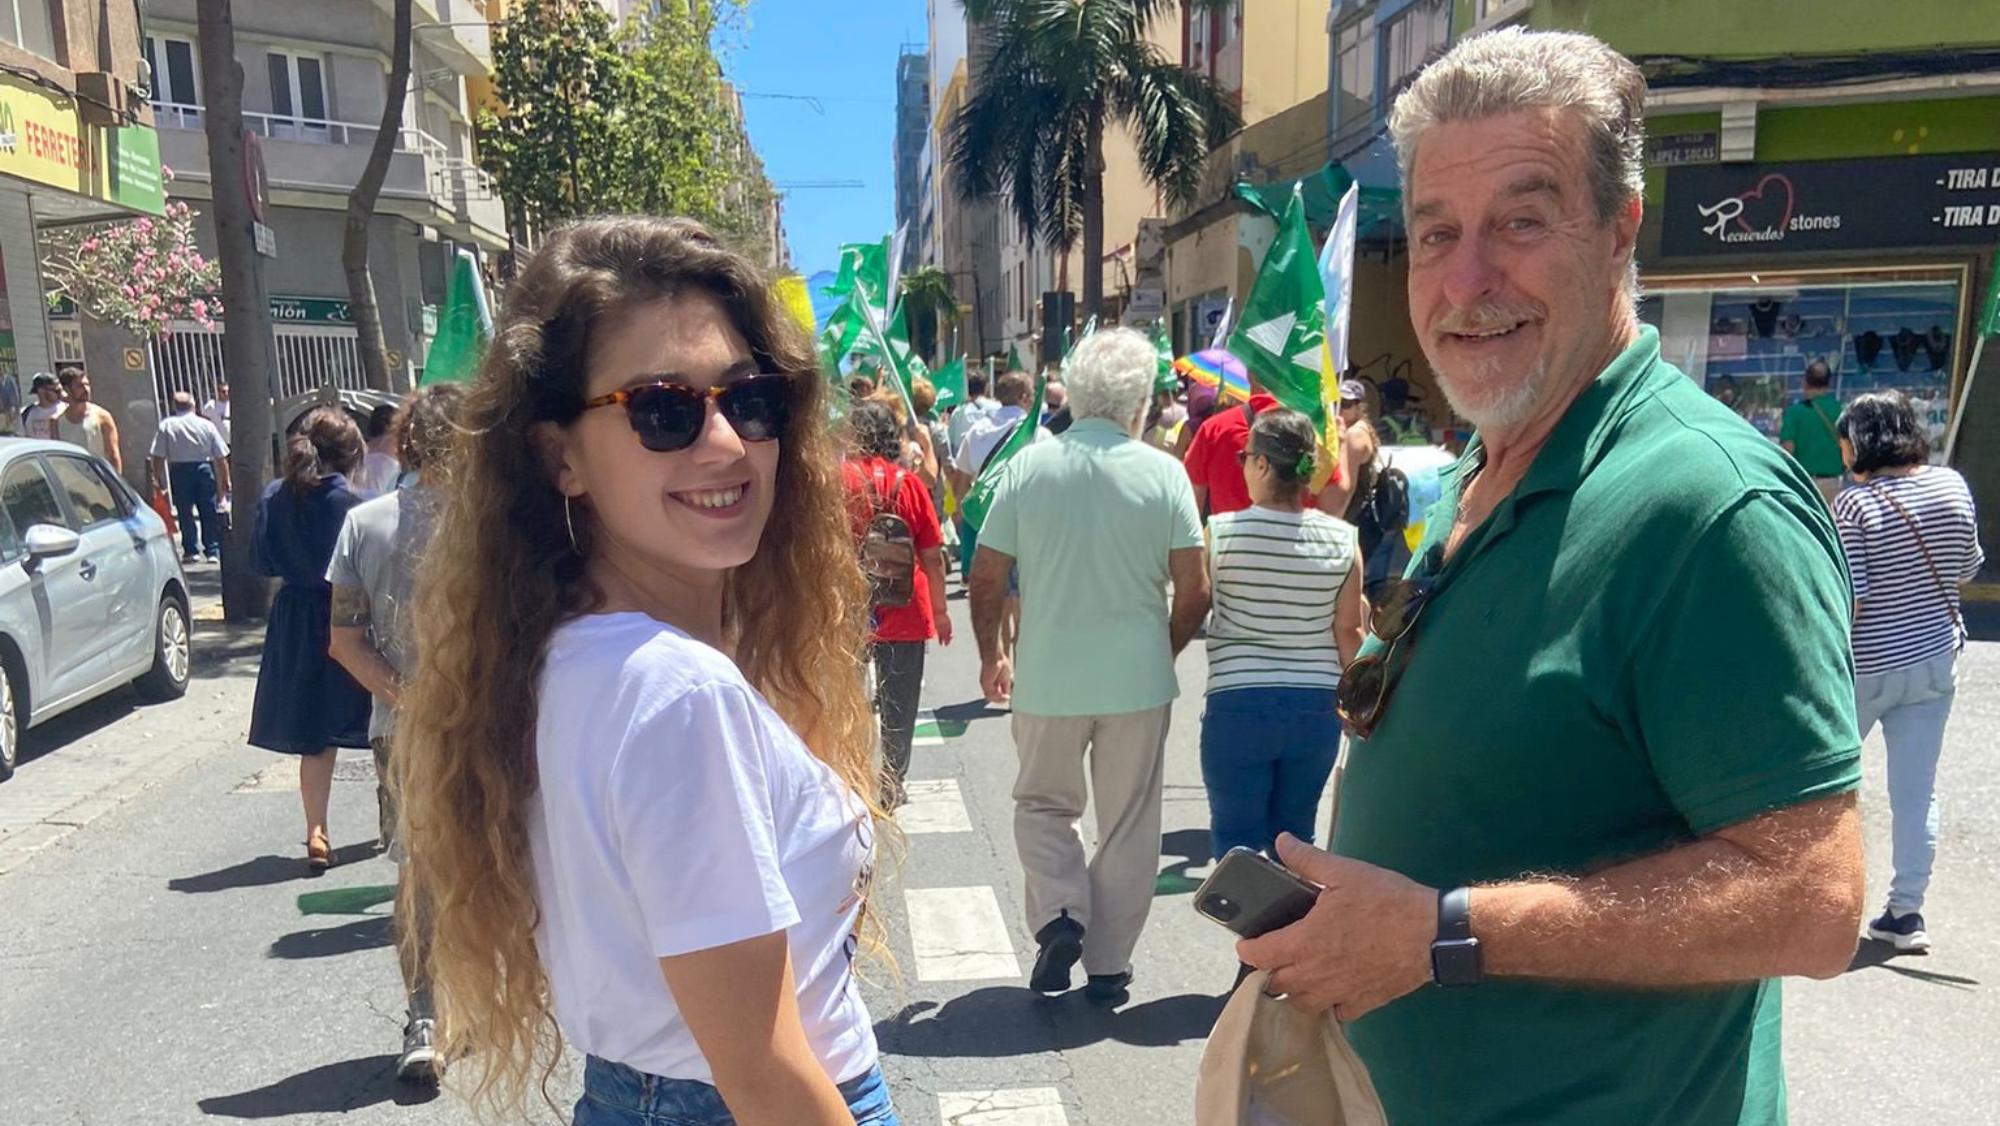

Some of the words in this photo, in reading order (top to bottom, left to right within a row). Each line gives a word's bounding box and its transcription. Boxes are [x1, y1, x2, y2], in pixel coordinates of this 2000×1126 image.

[1947, 168, 1988, 190] TIRA
[1698, 198, 1785, 242] Recuerdos
[1789, 214, 1841, 231] stones
[1943, 205, 1984, 227] TIRA
